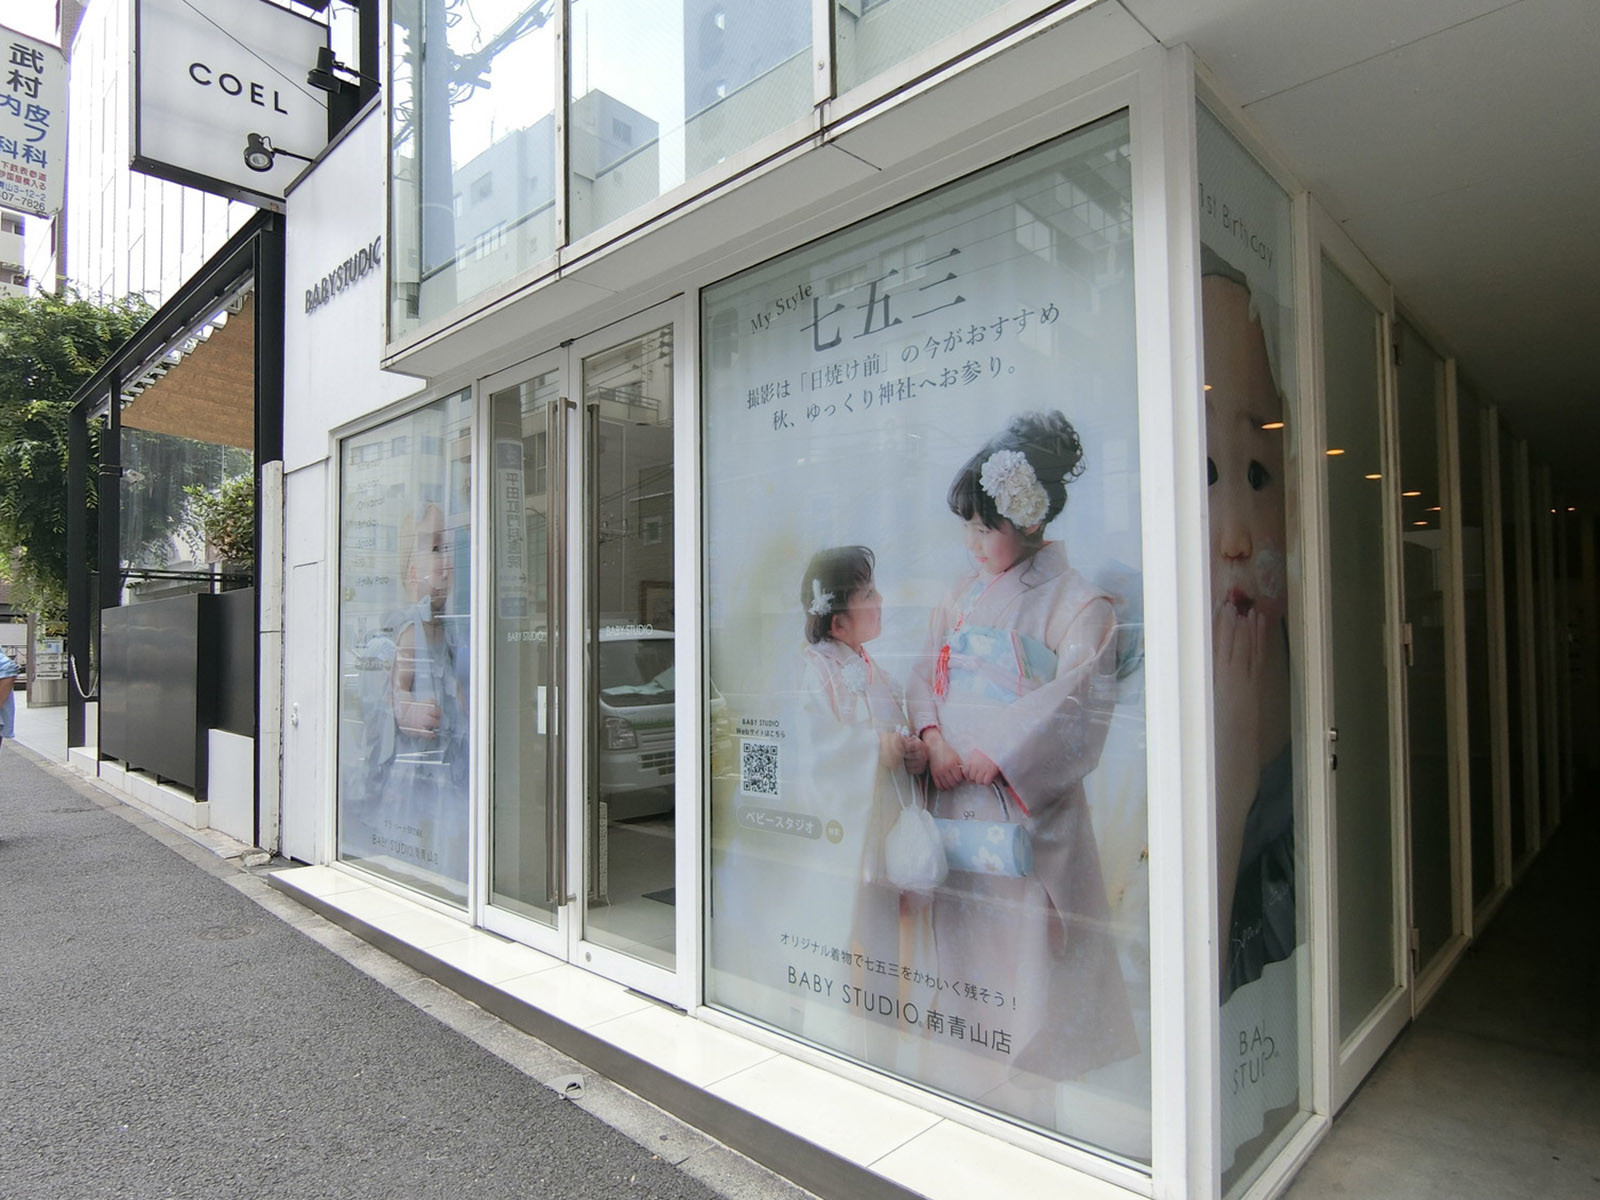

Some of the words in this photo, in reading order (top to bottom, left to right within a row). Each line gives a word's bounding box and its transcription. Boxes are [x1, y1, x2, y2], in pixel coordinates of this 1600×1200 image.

[6, 43, 44, 99] 武村
[189, 62, 288, 115] COEL
[22, 103, 50, 168] 皮フ科
[0, 191, 46, 211] 07-7826
[751, 310, 772, 335] My
[775, 282, 813, 316] Style
[800, 248, 966, 352] 七五三
[788, 966, 833, 997] BABY
[927, 1009, 1012, 1055] 南青山店
